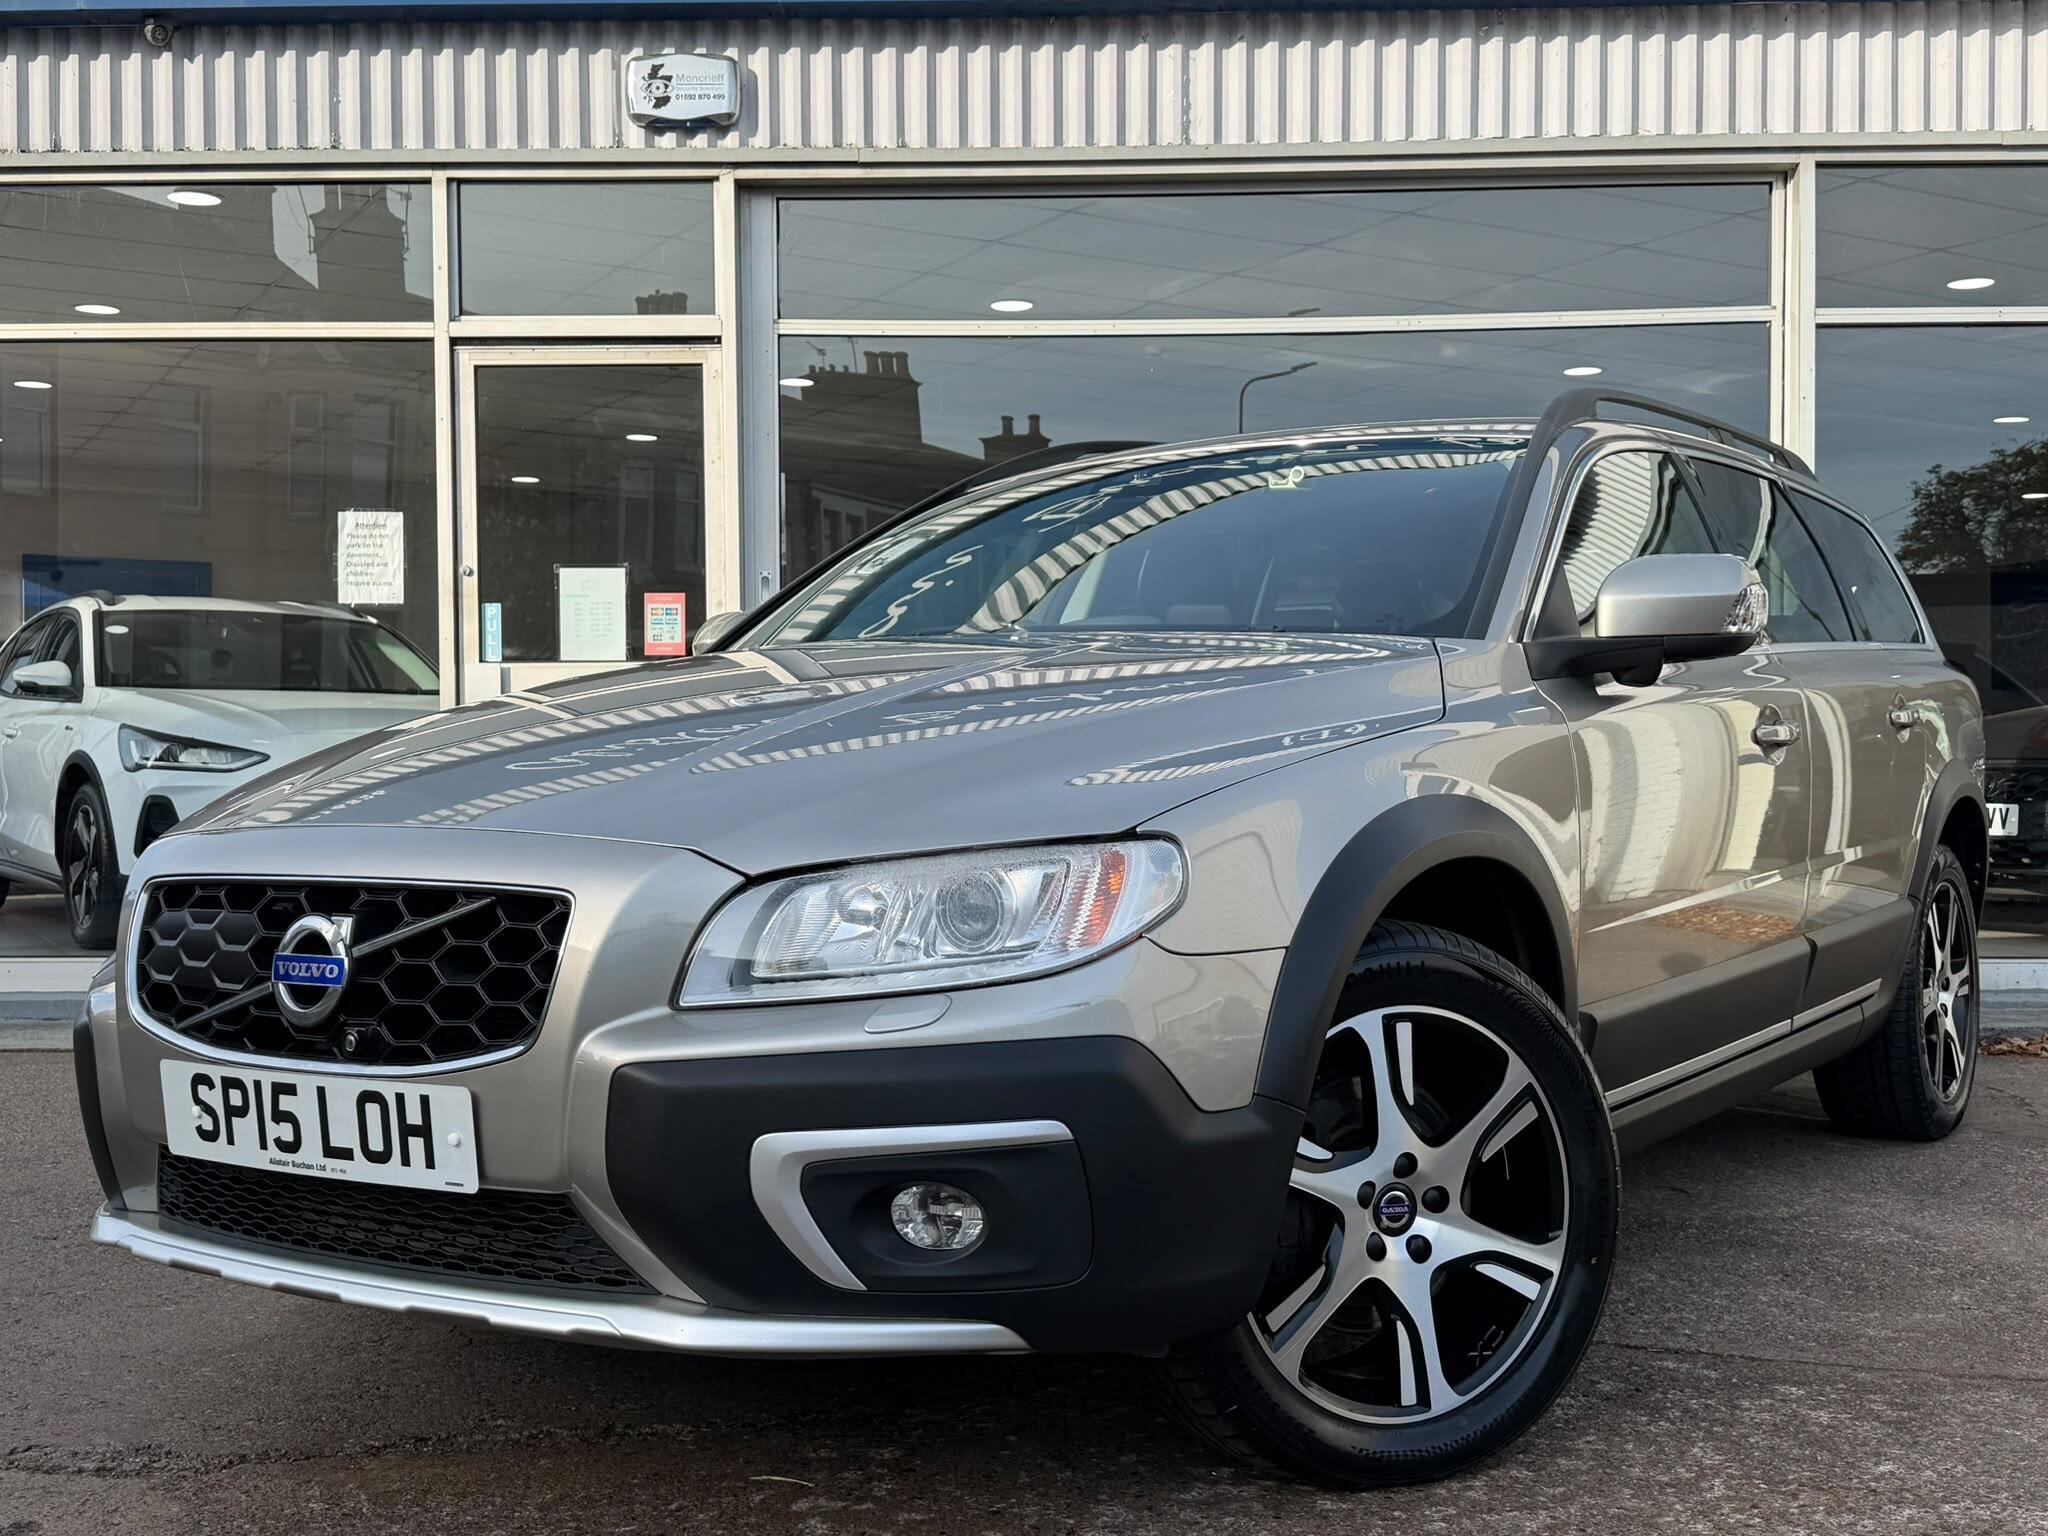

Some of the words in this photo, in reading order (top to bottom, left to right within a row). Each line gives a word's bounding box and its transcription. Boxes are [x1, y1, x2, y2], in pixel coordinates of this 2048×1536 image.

[675, 73, 725, 82] Moncrieff
[354, 521, 387, 529] Attention
[487, 607, 497, 658] PULL
[276, 961, 339, 978] VOLVO
[190, 1072, 302, 1154] SP15
[316, 1085, 436, 1170] LOH
[269, 1157, 291, 1167] Alistair
[291, 1160, 315, 1170] Buchan
[315, 1163, 327, 1172] Ltd
